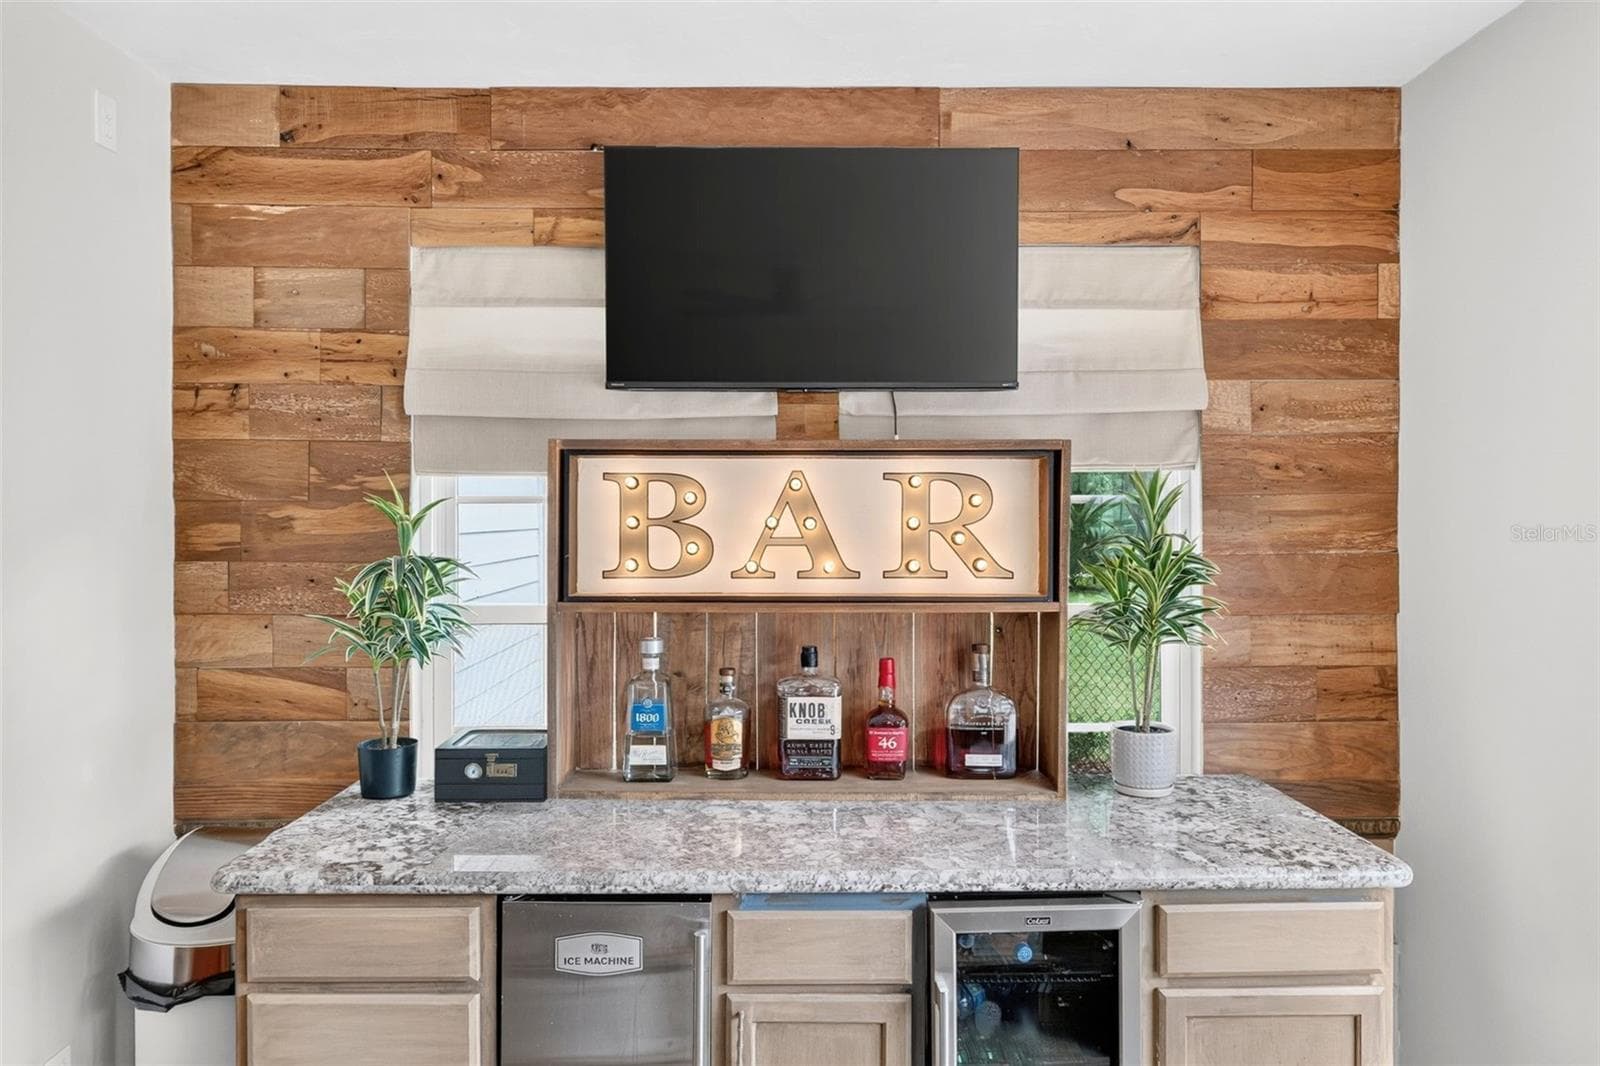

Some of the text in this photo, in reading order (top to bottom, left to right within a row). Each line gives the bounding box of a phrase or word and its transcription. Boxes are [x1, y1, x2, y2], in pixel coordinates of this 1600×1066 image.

[602, 470, 1014, 580] BAR
[789, 702, 825, 718] KNOB
[635, 712, 660, 723] 1800
[878, 736, 898, 749] 46
[564, 957, 634, 966] ICE MACHINE
